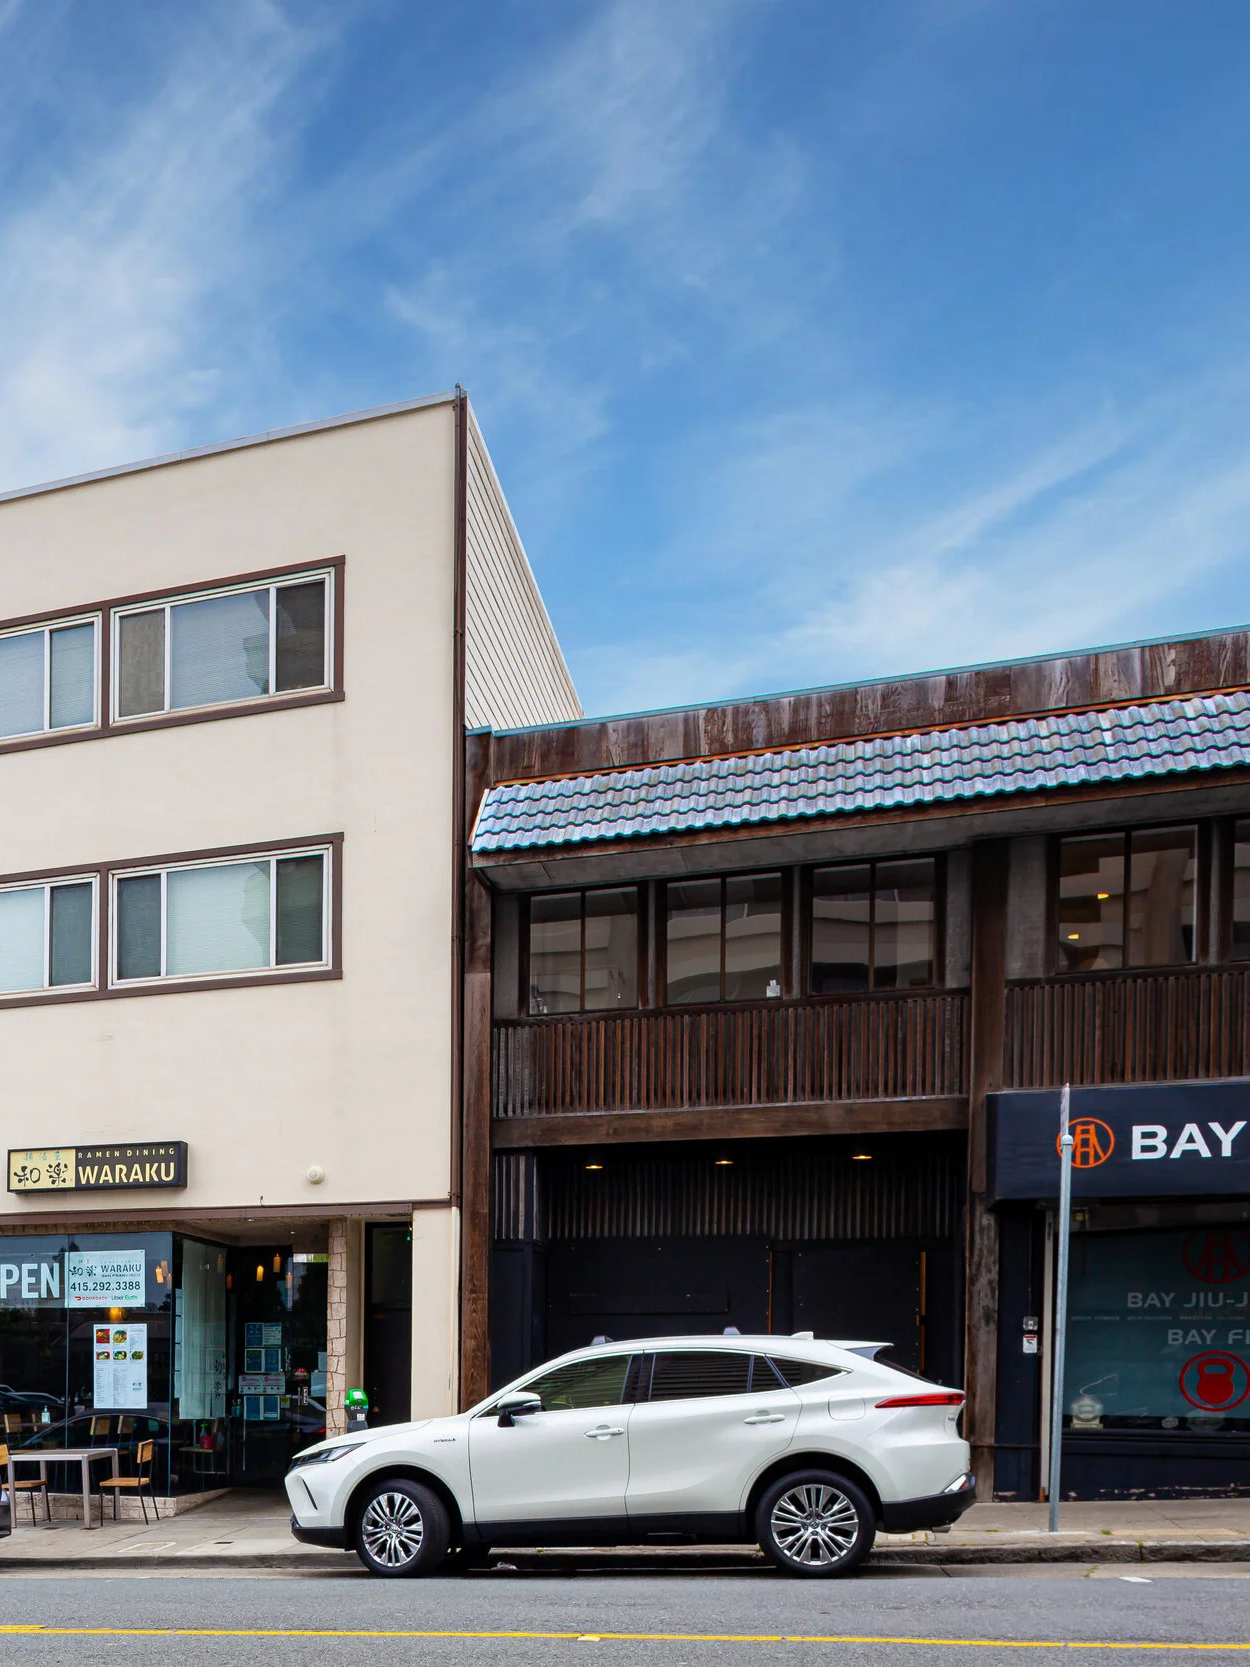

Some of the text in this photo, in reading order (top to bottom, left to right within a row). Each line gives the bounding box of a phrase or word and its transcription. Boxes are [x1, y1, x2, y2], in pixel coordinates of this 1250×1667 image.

[1132, 1121, 1248, 1160] BAY
[78, 1148, 175, 1159] RAMEN DINING
[78, 1162, 175, 1184] WARAKU
[101, 1264, 141, 1273] WARAKU
[71, 1281, 141, 1291] 415.292.3388
[1127, 1292, 1176, 1308] BAY
[1167, 1329, 1217, 1345] BAY
